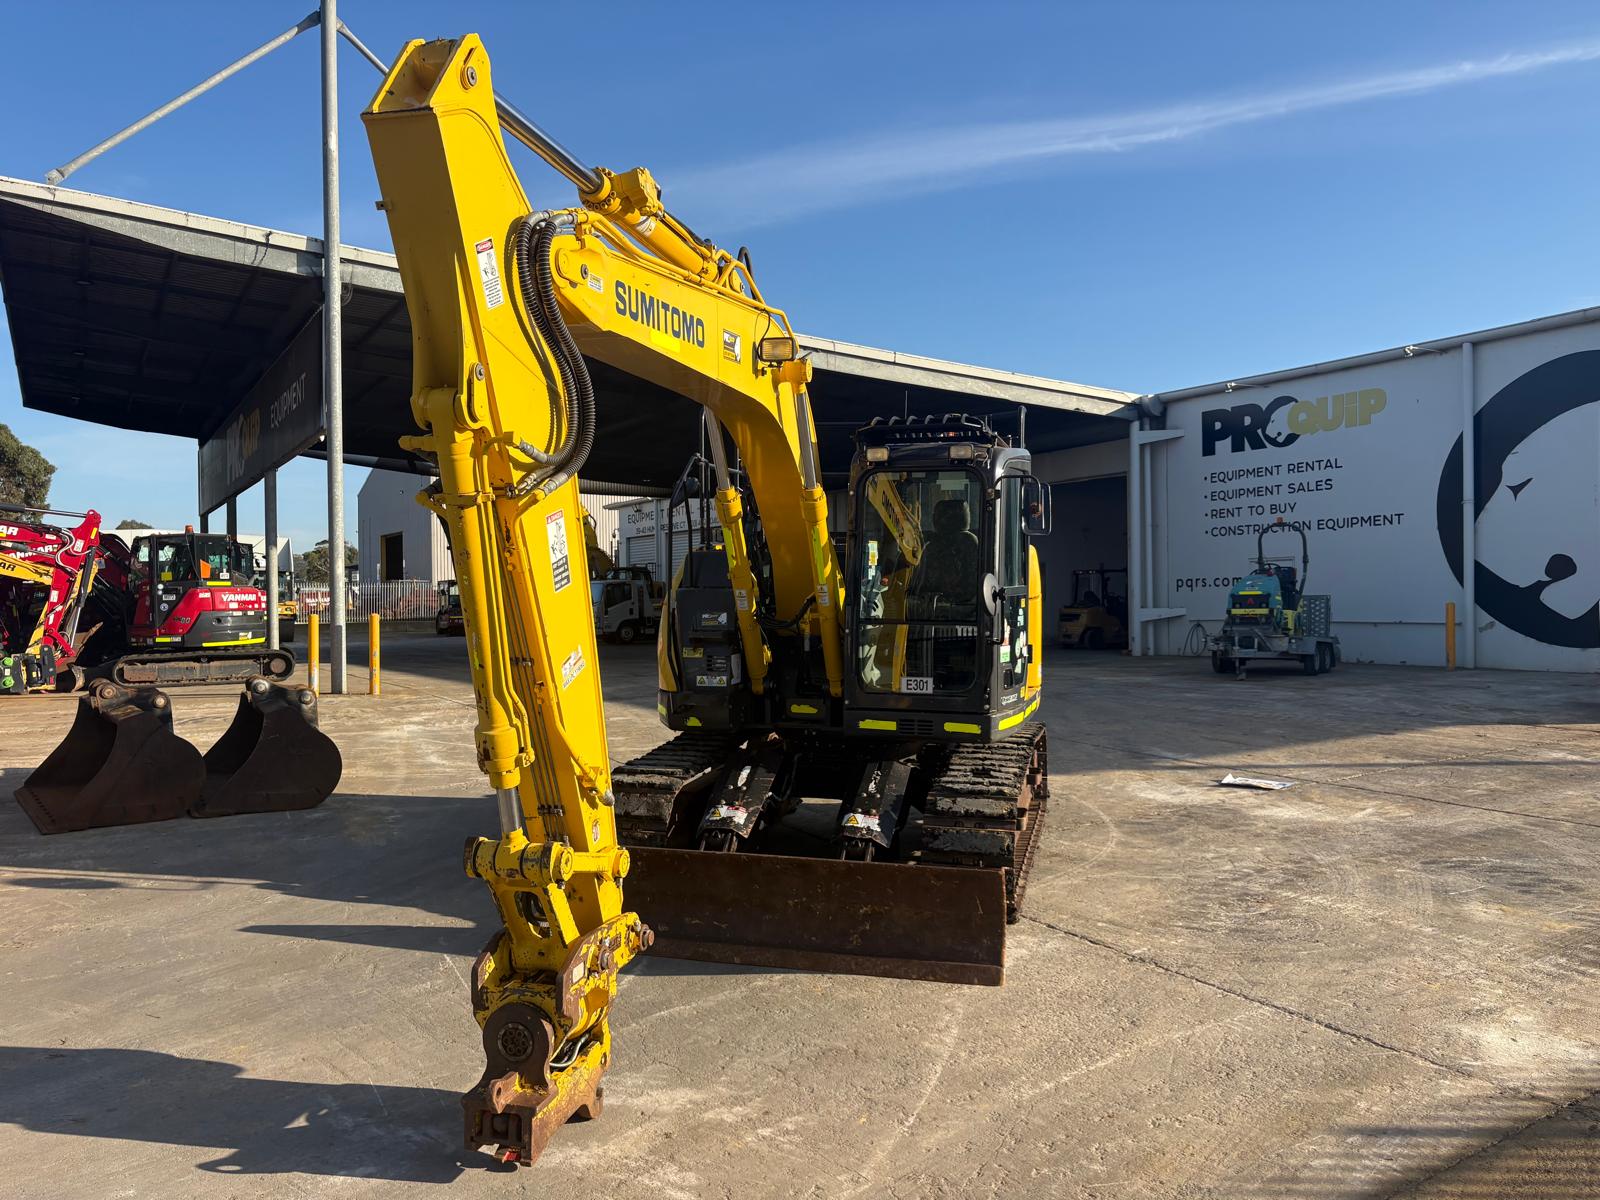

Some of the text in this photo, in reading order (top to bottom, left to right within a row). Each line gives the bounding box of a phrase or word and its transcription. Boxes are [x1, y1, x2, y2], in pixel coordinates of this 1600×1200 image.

[615, 280, 705, 349] SUMITOMO
[270, 373, 306, 429] EQUIPMENT
[1210, 458, 1344, 484] EQUIPMENT RENTAL
[1210, 478, 1334, 501] EQUIPMENT SALES
[1210, 502, 1297, 519] RENT TO BUY
[1317, 513, 1405, 531] EQUIPMENT
[1176, 575, 1242, 592] pqrs.com
[221, 593, 257, 602] YANMAR
[906, 679, 929, 691] E301
